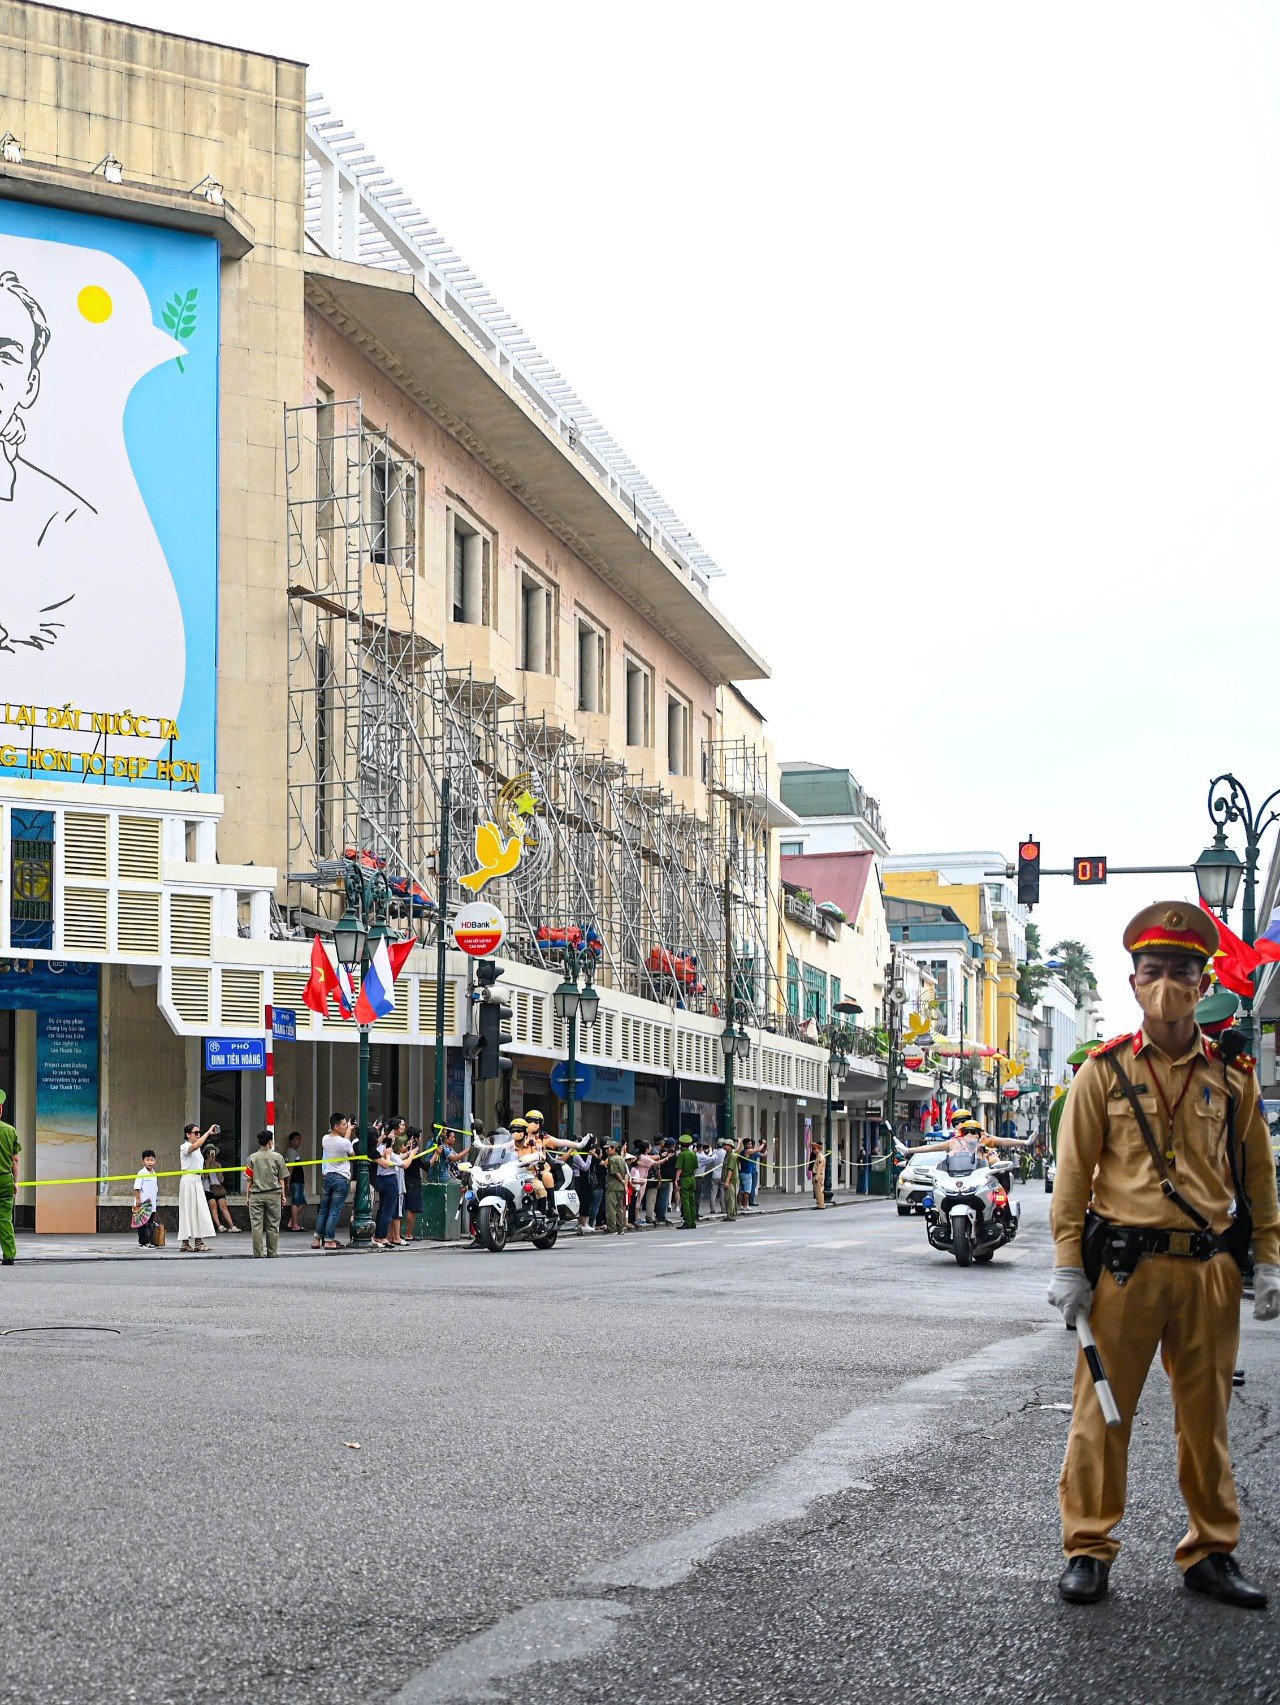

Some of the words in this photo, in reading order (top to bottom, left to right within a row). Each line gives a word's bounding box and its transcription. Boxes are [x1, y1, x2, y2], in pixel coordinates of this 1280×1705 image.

[5, 703, 36, 731] LẠI
[46, 699, 82, 731] ĐẤT
[92, 709, 151, 738] NƯỚC
[158, 718, 180, 740] TA
[27, 748, 72, 772] HƠN
[81, 753, 106, 775] TO
[113, 756, 149, 783] ĐẸP
[157, 760, 200, 784] HƠN
[1078, 861, 1103, 880] 01
[231, 1041, 250, 1050] PHỐ
[227, 1052, 239, 1065] TIÊN
[241, 1052, 261, 1065] HOÀNG
